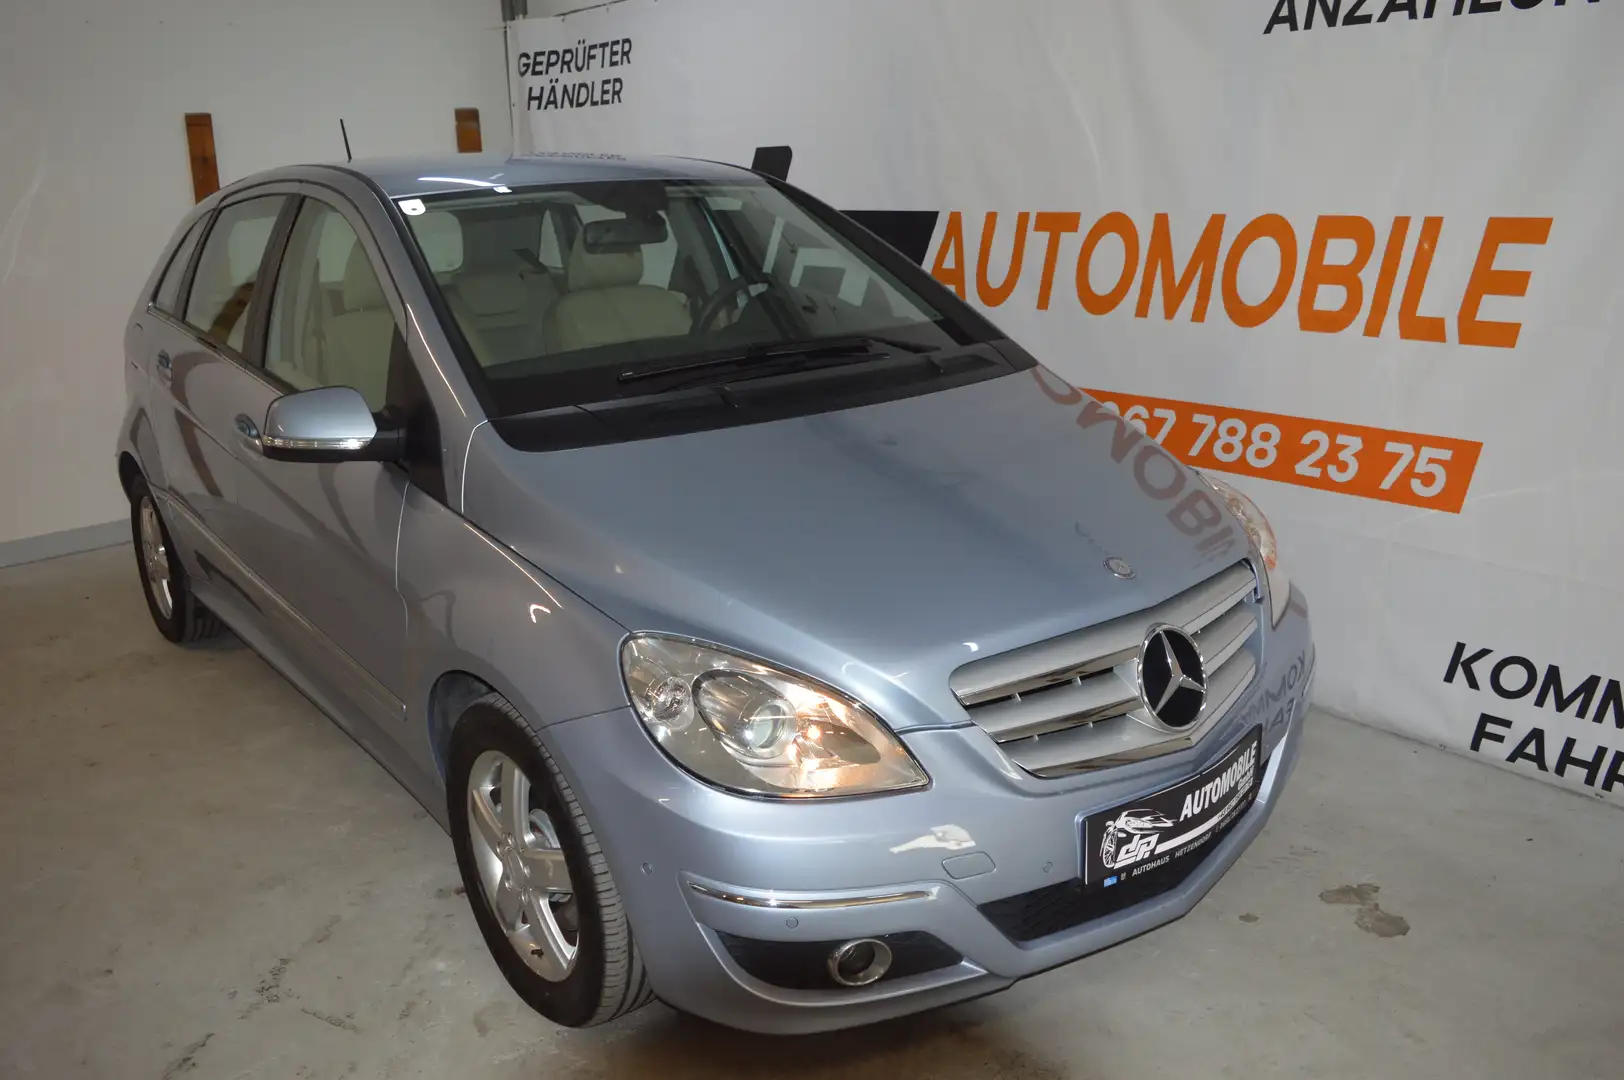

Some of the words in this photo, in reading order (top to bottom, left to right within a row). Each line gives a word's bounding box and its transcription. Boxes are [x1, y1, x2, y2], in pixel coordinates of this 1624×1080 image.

[517, 38, 632, 78] GEPRÜFTER
[527, 78, 623, 111] HÄNDLER
[930, 211, 1554, 349] AUTOMOBILE
[1187, 413, 1281, 469] 788
[1294, 429, 1363, 483] 23
[1378, 441, 1453, 498] 75
[1179, 740, 1258, 822] AUTOMOBILE
[1131, 855, 1170, 877] AUTOHAUS
